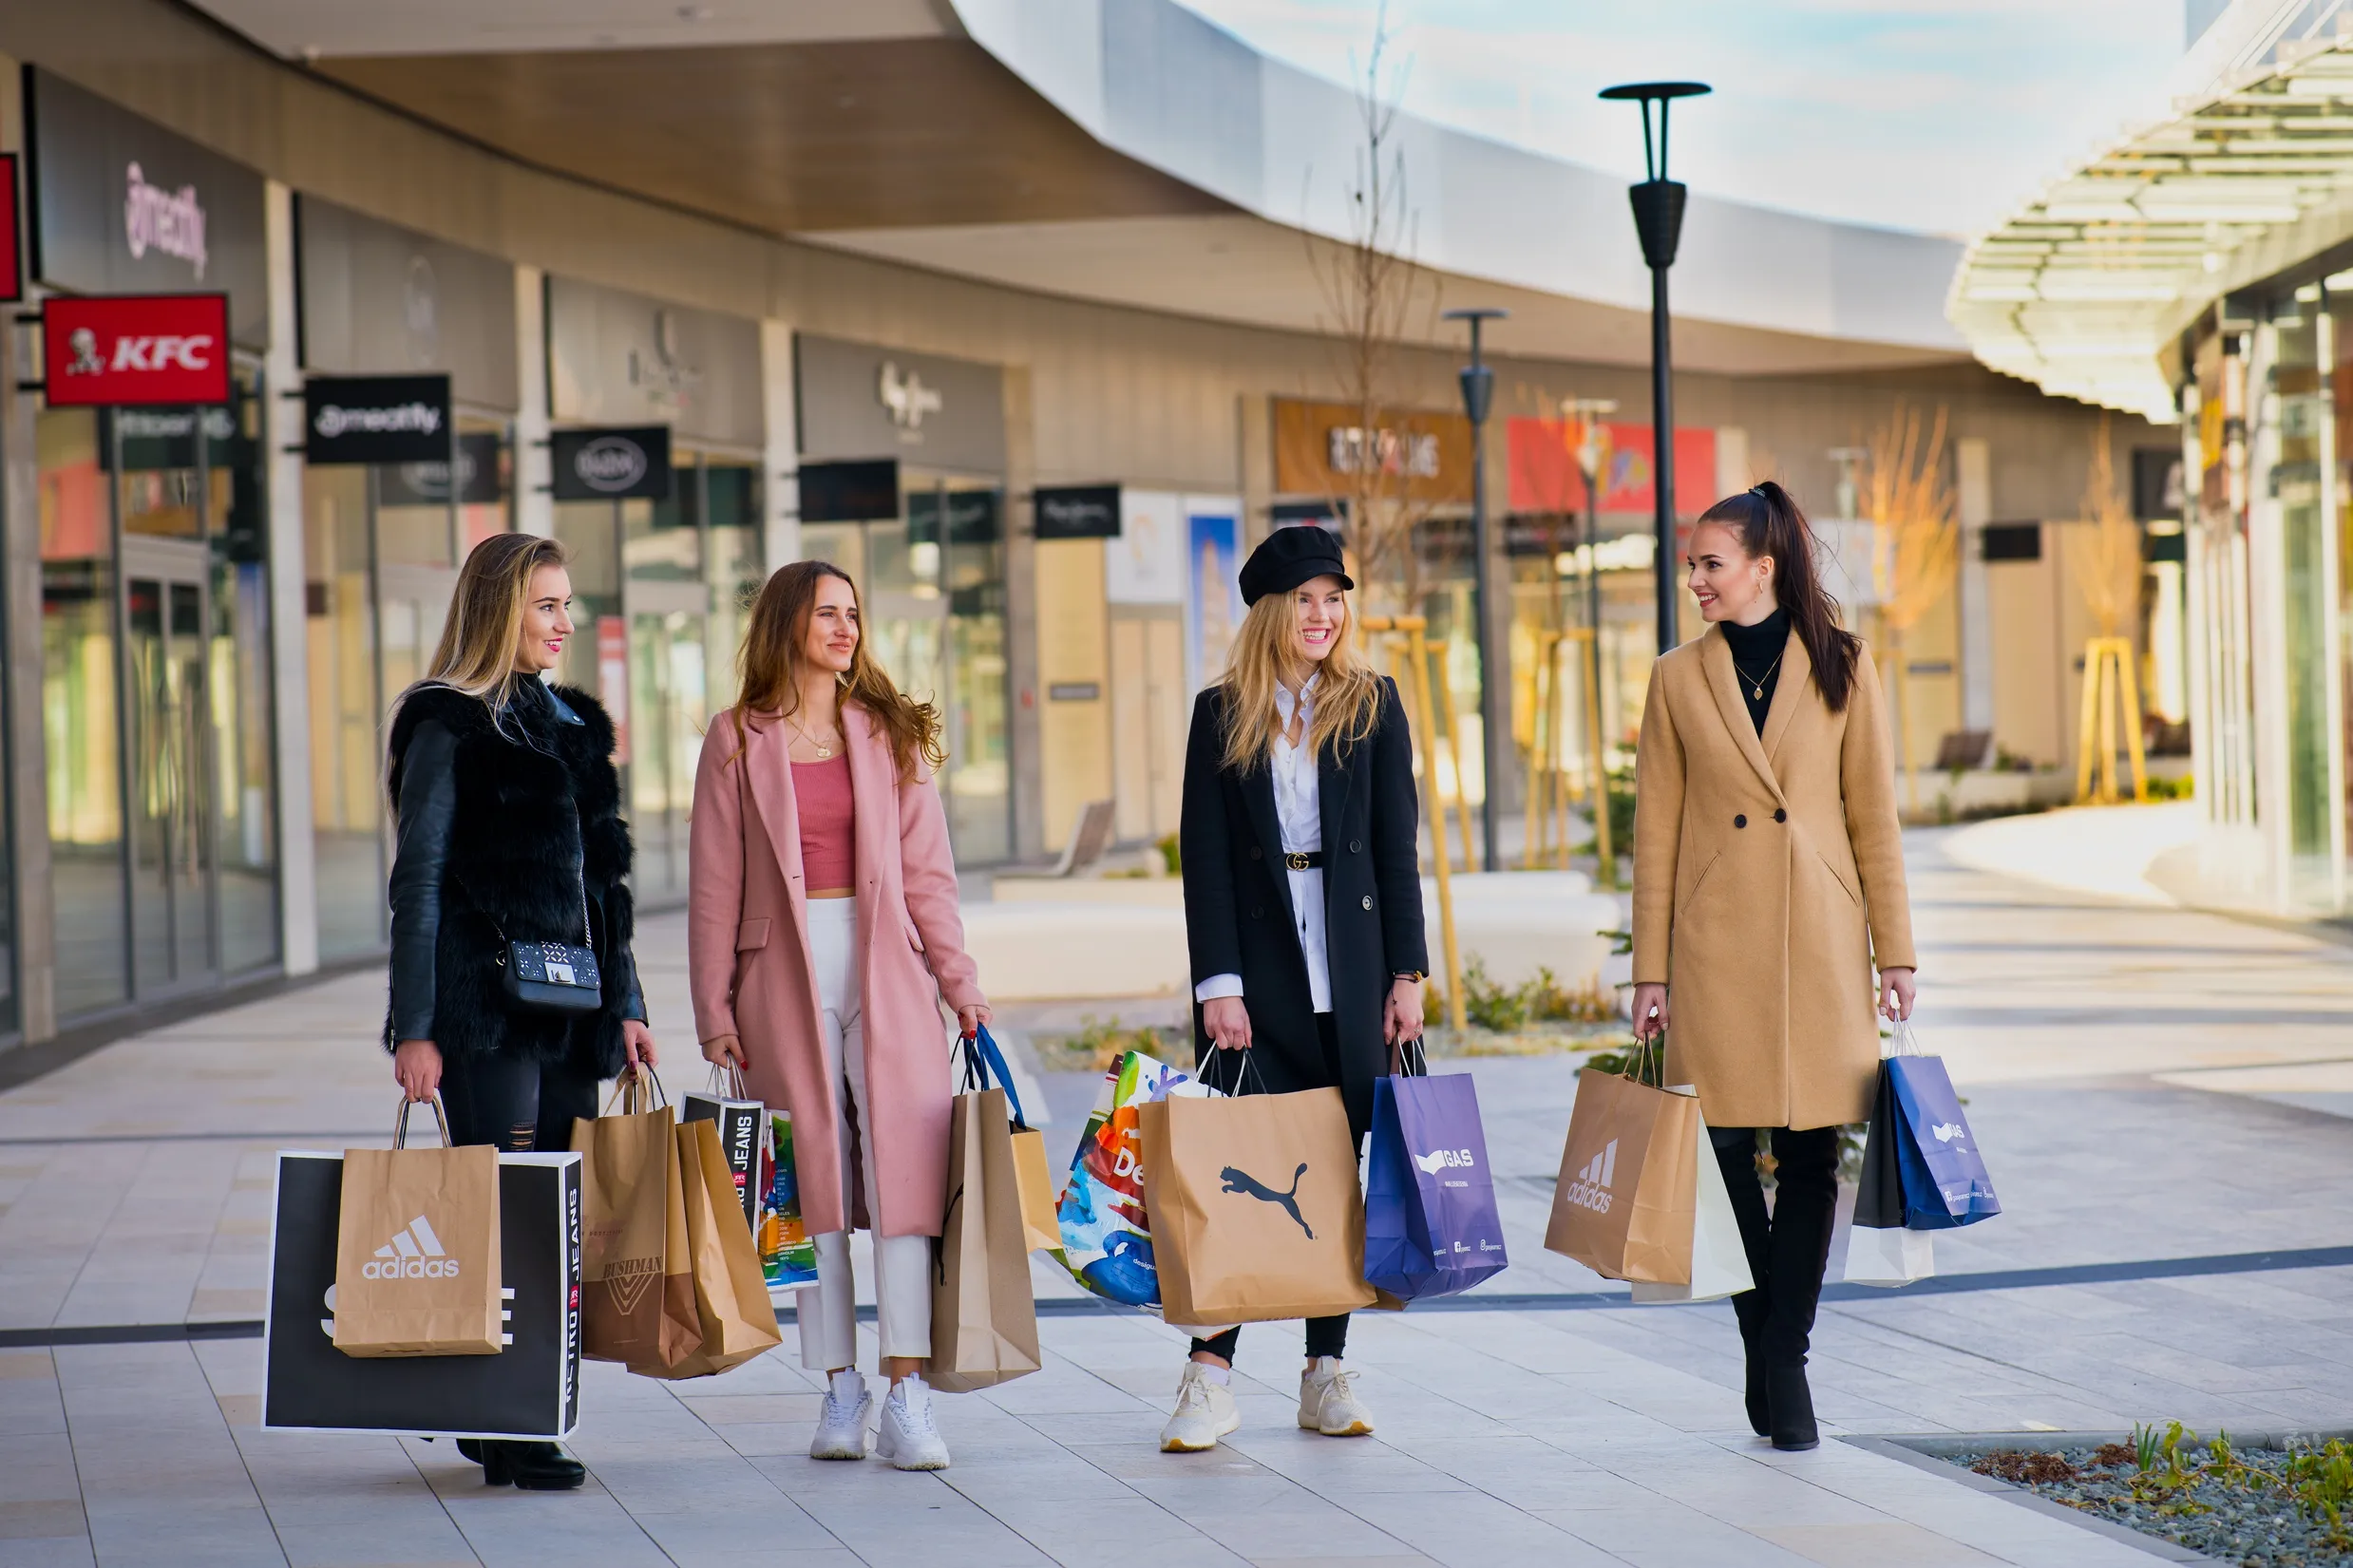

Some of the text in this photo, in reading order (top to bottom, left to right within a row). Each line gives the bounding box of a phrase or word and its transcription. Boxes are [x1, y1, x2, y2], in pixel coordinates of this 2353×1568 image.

[110, 334, 214, 371] KFC
[733, 1116, 752, 1171] JEANS
[1443, 1148, 1474, 1168] GAS
[1566, 1179, 1613, 1214] adidas
[569, 1187, 579, 1281] JEANS
[362, 1255, 460, 1280] adidas
[602, 1256, 663, 1279] BUSHMAN
